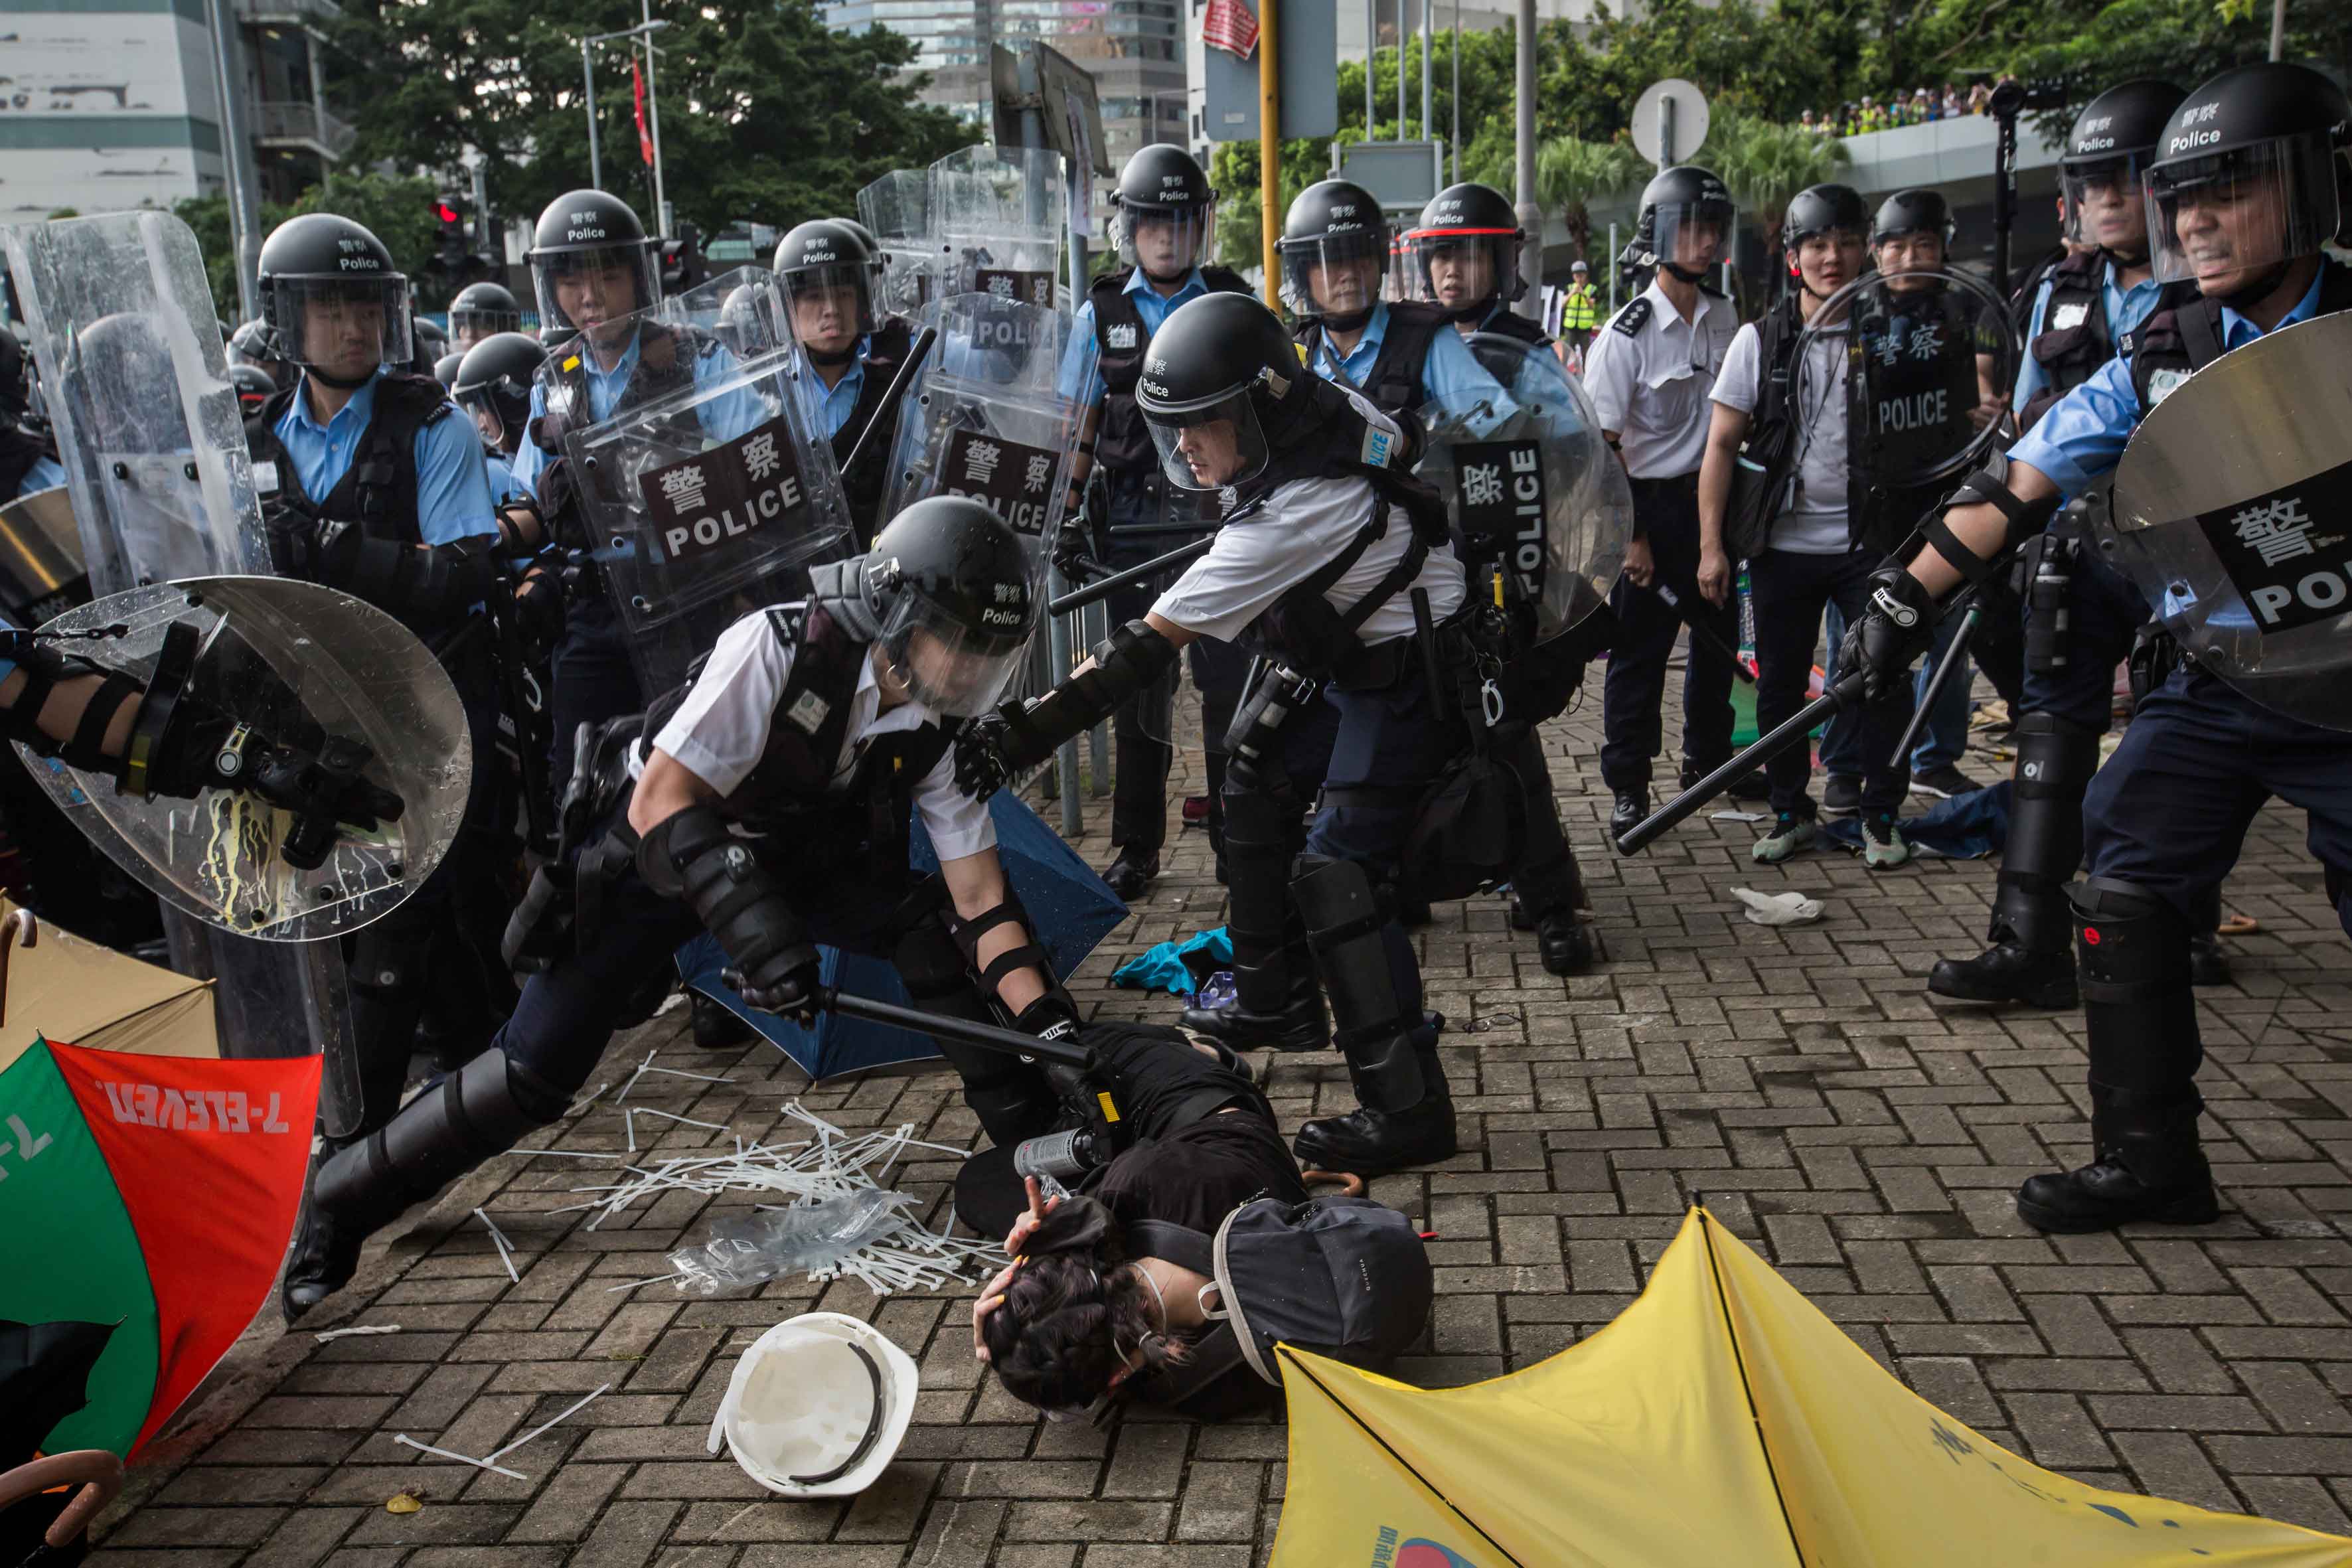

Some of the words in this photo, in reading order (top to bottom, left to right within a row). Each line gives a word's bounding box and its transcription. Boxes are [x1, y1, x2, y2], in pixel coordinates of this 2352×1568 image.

[2078, 137, 2114, 153] Police
[2170, 130, 2221, 154] Police
[1160, 191, 1189, 202] Police
[568, 227, 605, 242] Police
[1433, 213, 1464, 226] Police
[340, 257, 379, 270] Police
[803, 252, 835, 265] Police
[1875, 324, 1944, 366] 警察
[1142, 378, 1168, 396] Police
[1879, 388, 1948, 435] POLICE
[1370, 431, 1388, 466] OLICE
[659, 432, 781, 515] 警察
[965, 439, 1051, 493] 警察
[1462, 463, 1503, 505] 察
[665, 476, 801, 557] POLICE
[949, 487, 1046, 530] LICE
[2231, 498, 2314, 568] 警
[2250, 561, 2352, 624] PO
[982, 608, 1020, 625] Police
[1360, 1259, 1371, 1291] QUECHUA
